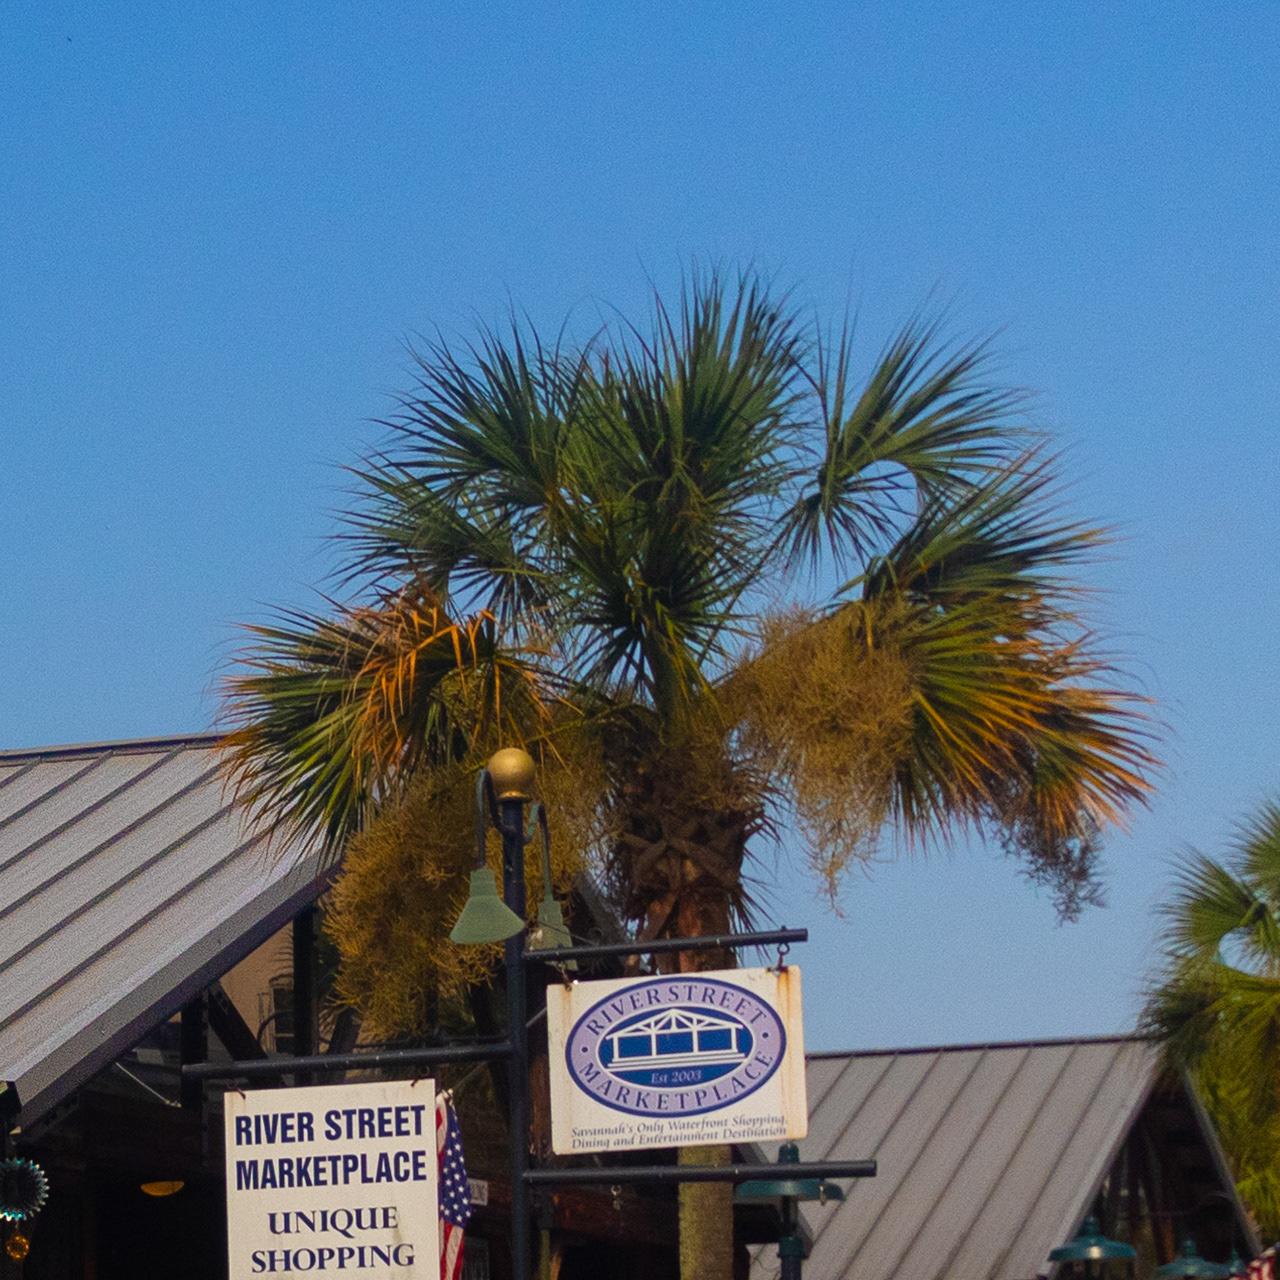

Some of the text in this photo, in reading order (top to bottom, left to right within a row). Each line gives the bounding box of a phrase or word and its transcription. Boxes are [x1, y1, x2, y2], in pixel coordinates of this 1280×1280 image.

[586, 984, 768, 1036] RIVER STREET
[579, 1050, 773, 1111] MARKETPLACE
[672, 1070, 702, 1083] 2003
[235, 1105, 426, 1146] RIVER STREET
[571, 1122, 634, 1138] Savannah's
[637, 1120, 664, 1136] Only
[668, 1116, 728, 1134] Waterfront
[572, 1124, 787, 1150] Dining and Entertainment Destination
[236, 1150, 427, 1191] MARKETPLACE
[267, 1206, 398, 1239] UNIQUE
[251, 1243, 415, 1273] SHOPPING
